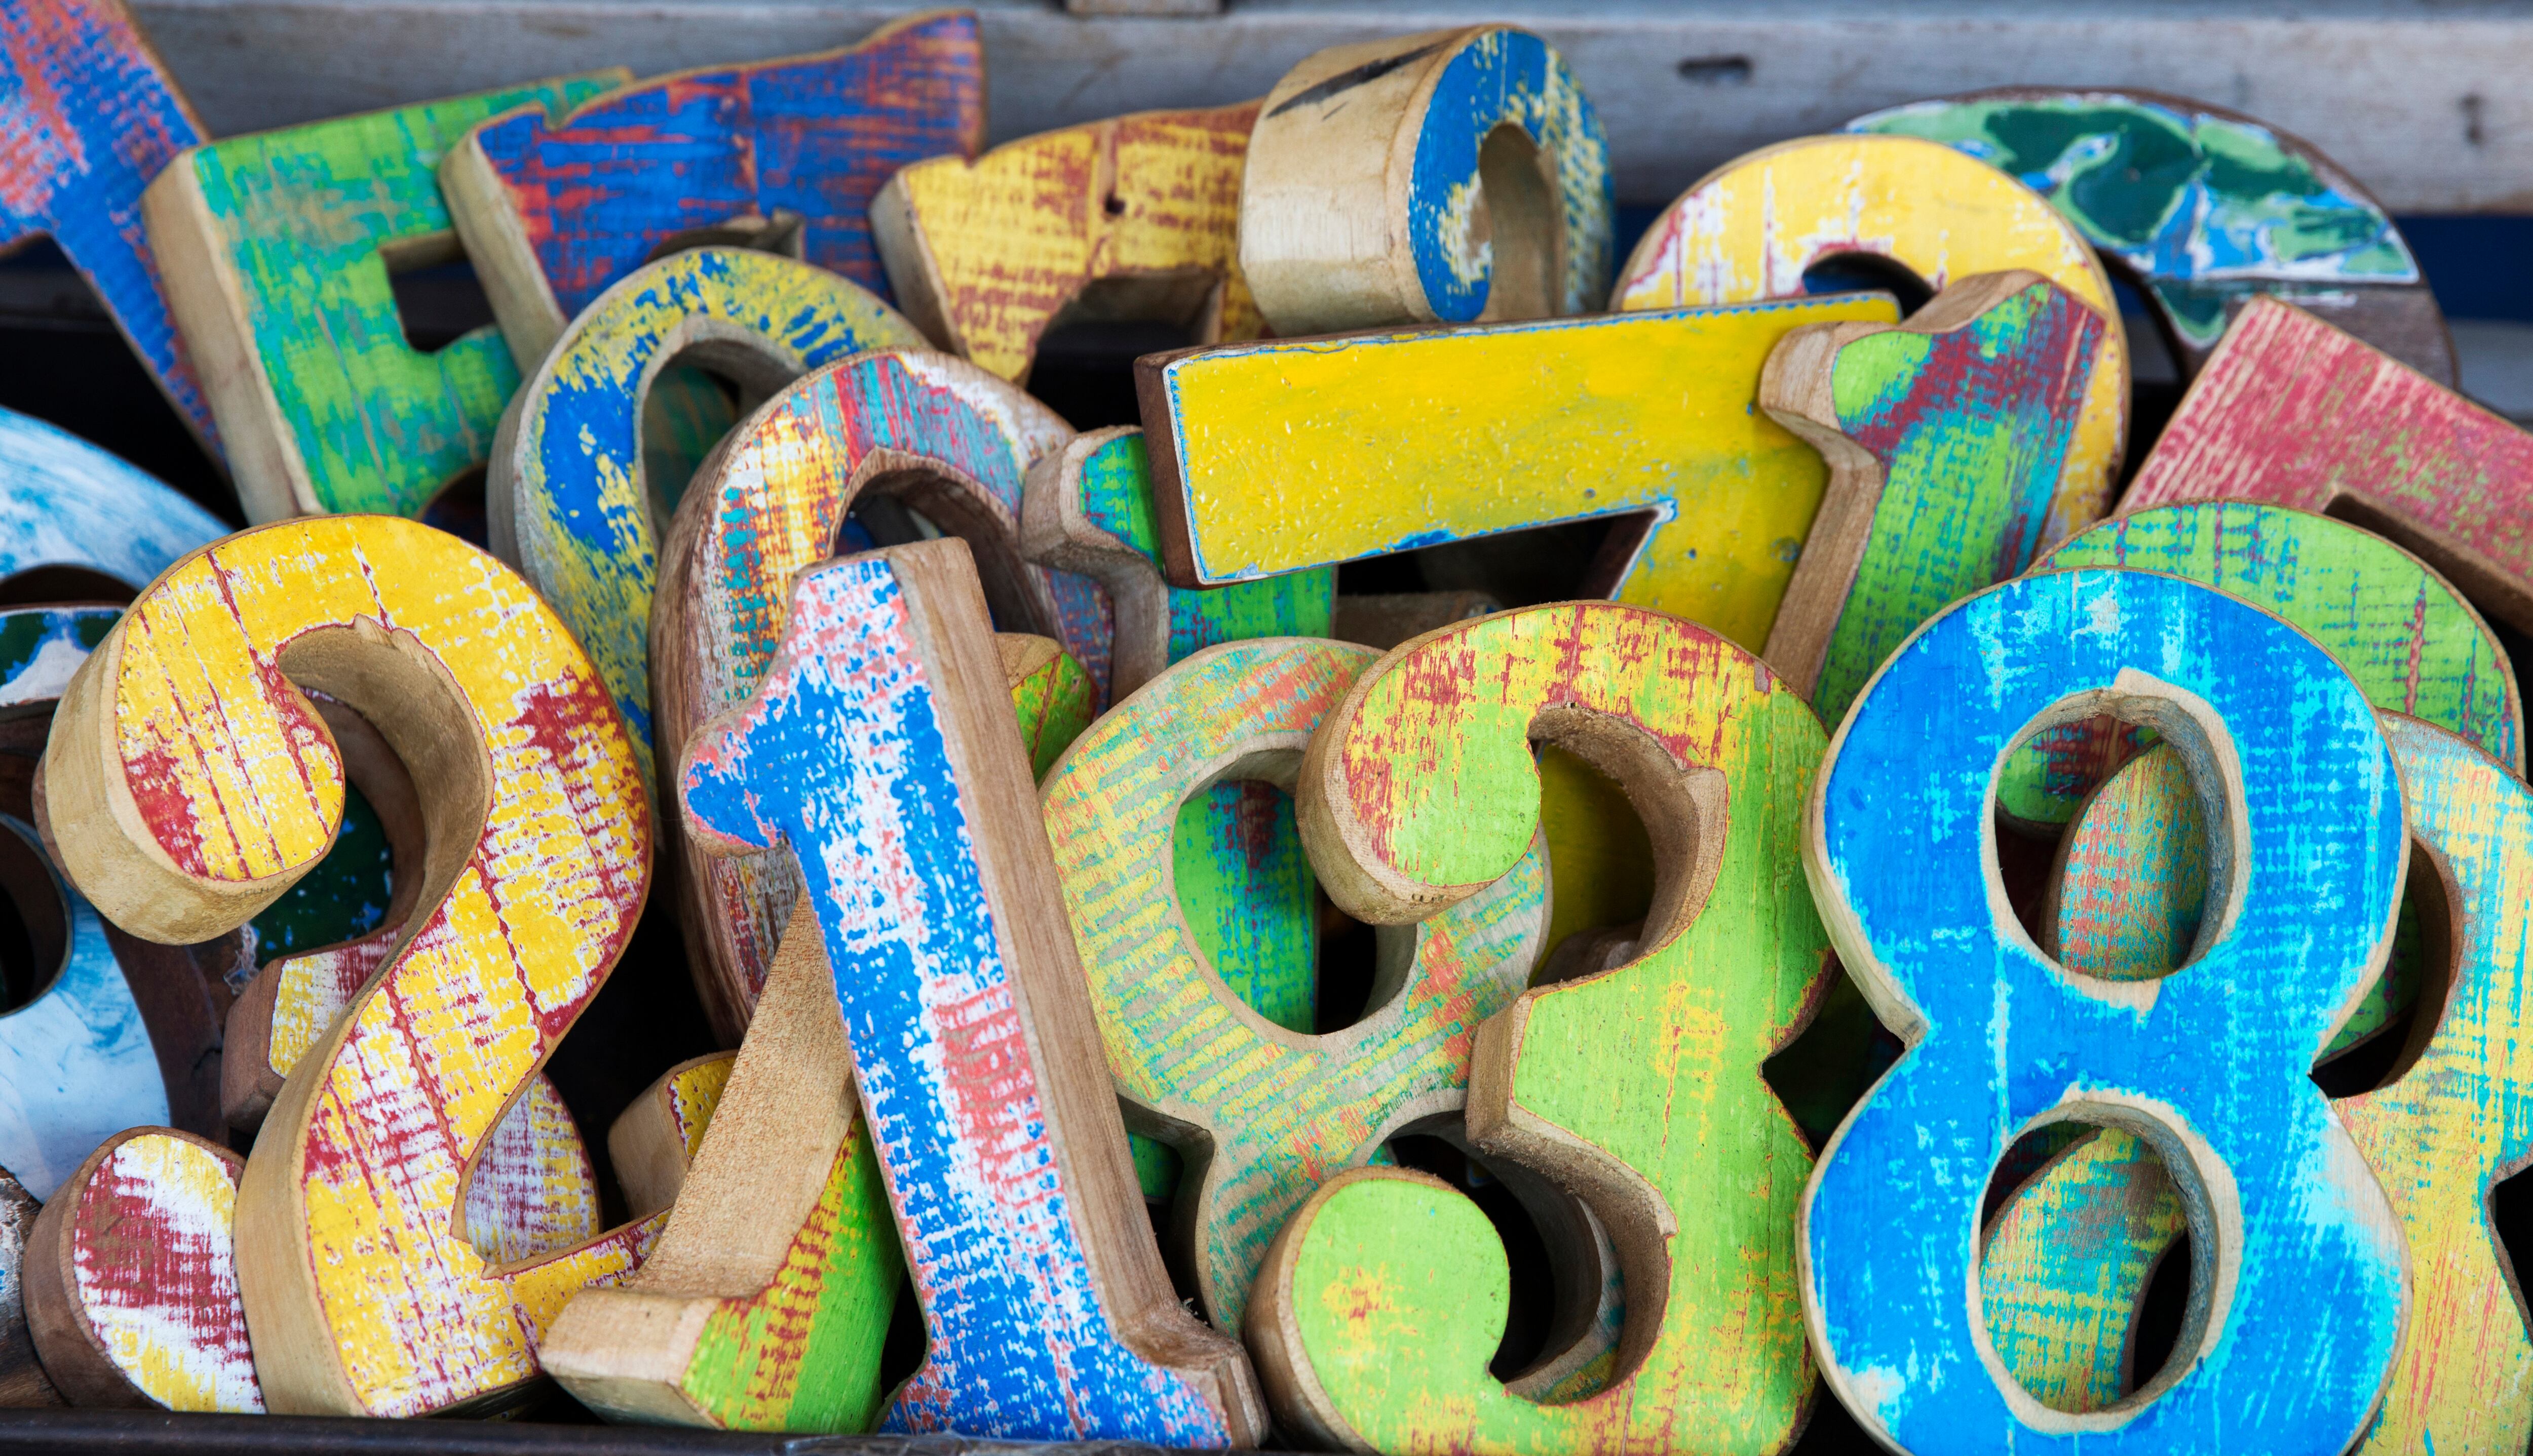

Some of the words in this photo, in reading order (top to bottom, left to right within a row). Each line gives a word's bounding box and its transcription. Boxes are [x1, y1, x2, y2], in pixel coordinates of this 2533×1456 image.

[38, 516, 709, 1418] 2
[679, 538, 1261, 1449] 1
[1246, 601, 1834, 1456] 3
[1799, 568, 2411, 1456] 8
